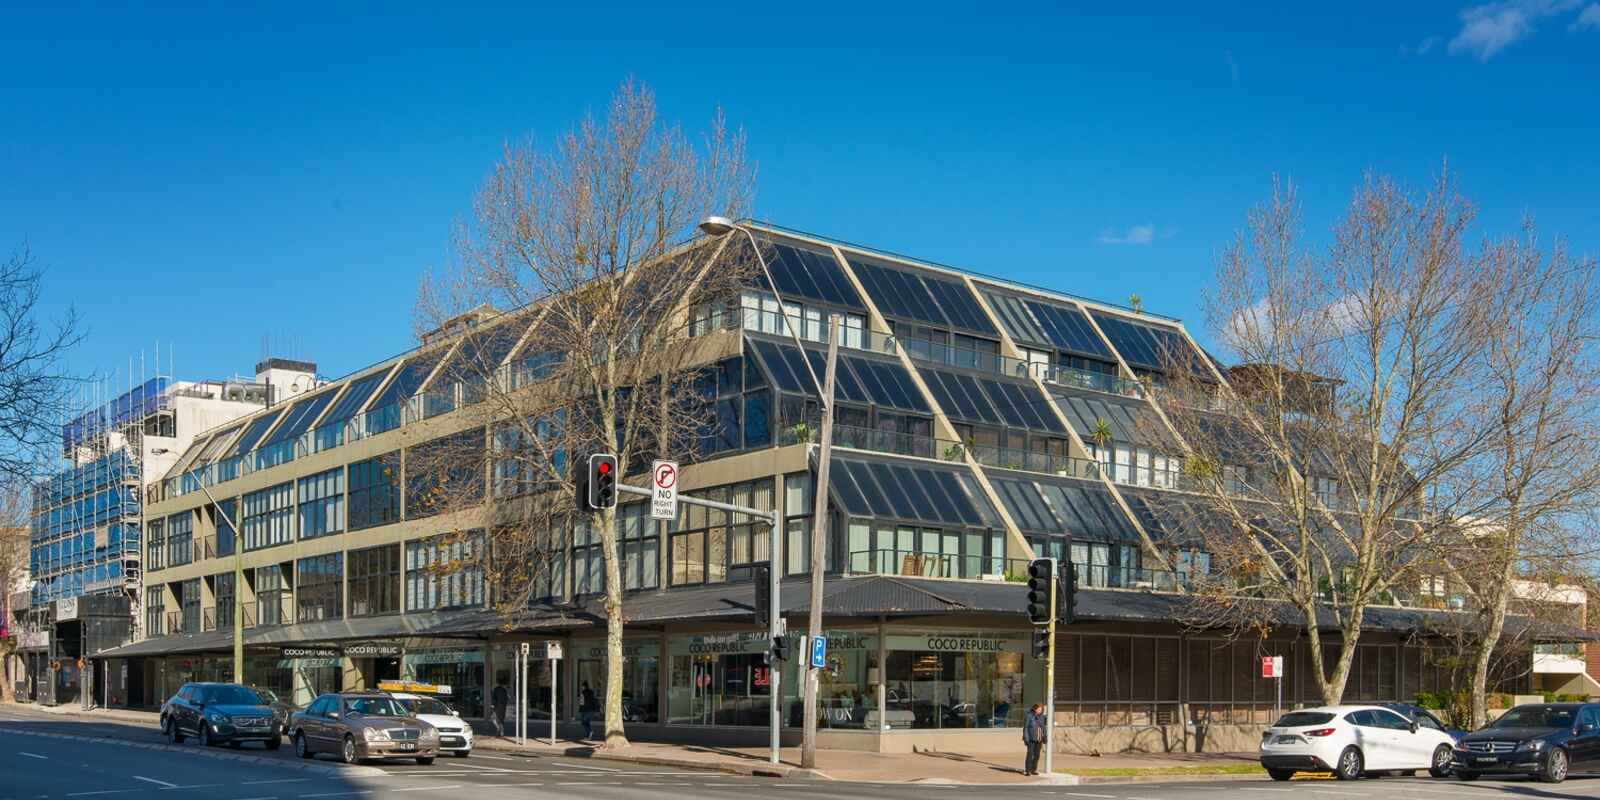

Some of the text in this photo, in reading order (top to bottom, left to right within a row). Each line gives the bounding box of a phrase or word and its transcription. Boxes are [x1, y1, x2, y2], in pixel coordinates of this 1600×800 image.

[658, 490, 672, 499] NO
[654, 500, 673, 508] RIGHT
[656, 508, 673, 516] TURN
[816, 639, 823, 648] P
[927, 638, 1004, 651] COCO REPUBLIC
[284, 648, 305, 656] COCO
[344, 646, 365, 654] COCO
[689, 642, 711, 654] COCO
